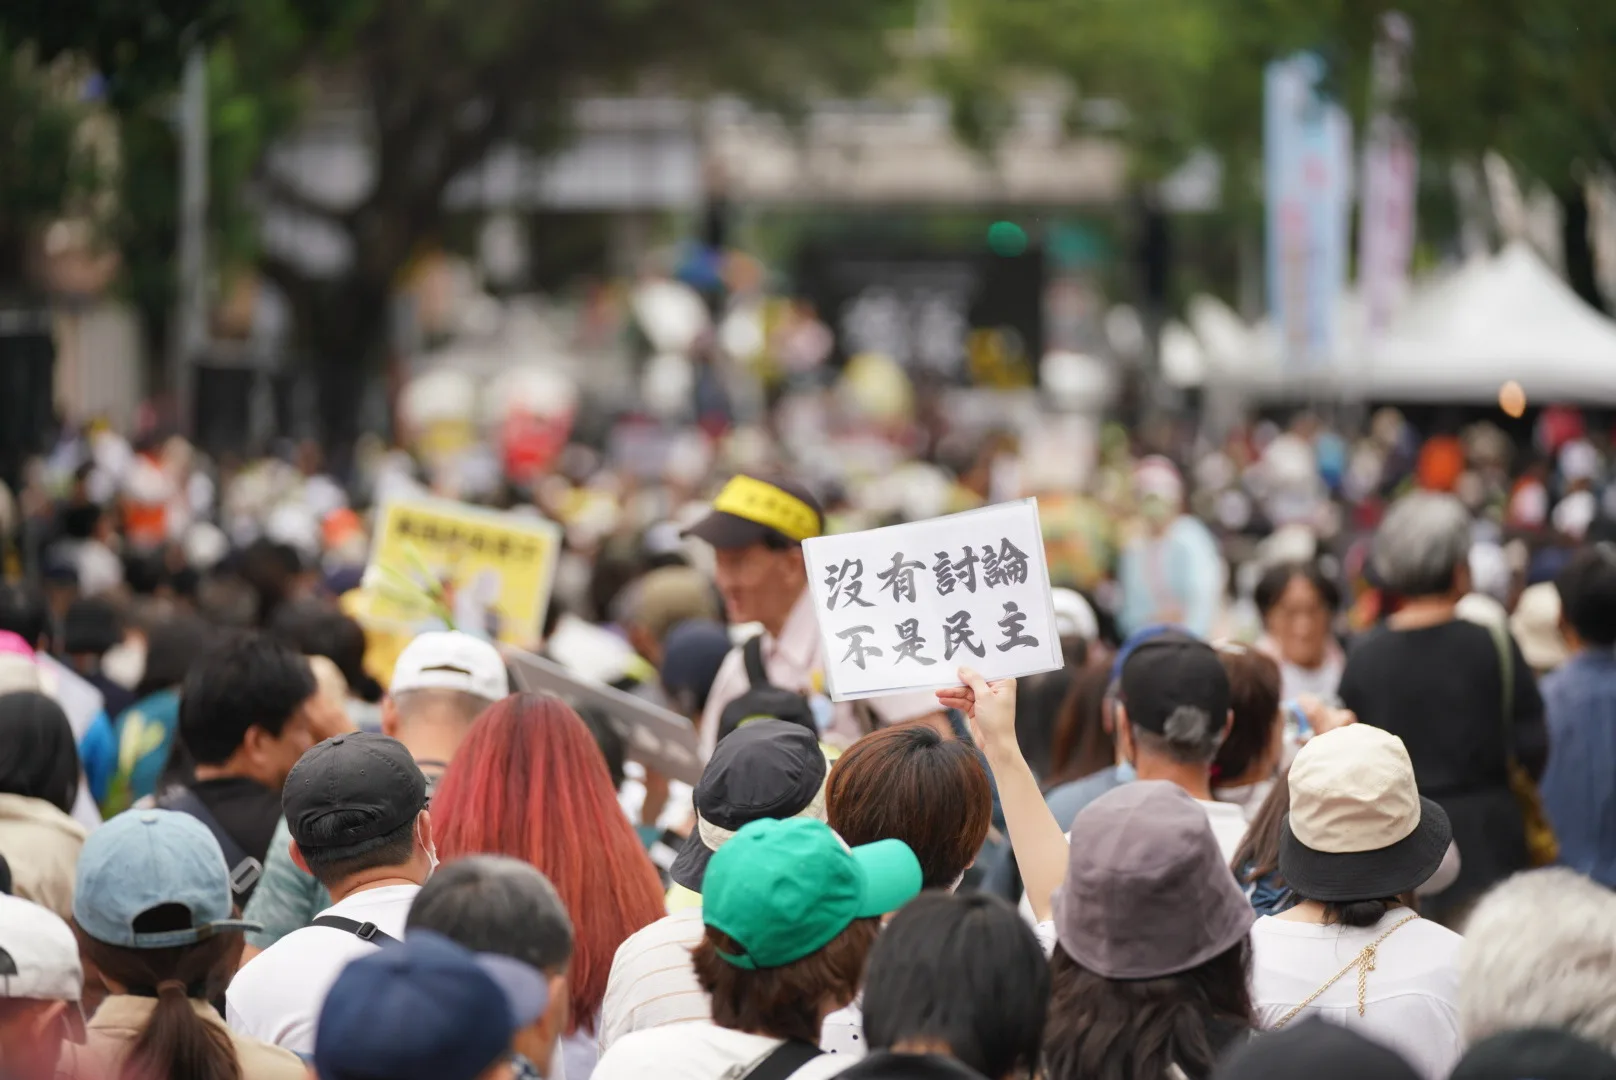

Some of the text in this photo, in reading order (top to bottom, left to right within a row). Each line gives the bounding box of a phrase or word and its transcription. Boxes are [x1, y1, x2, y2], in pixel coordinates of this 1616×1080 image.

[824, 537, 1029, 611] 沒有討論
[834, 601, 1040, 670] 不是民主
